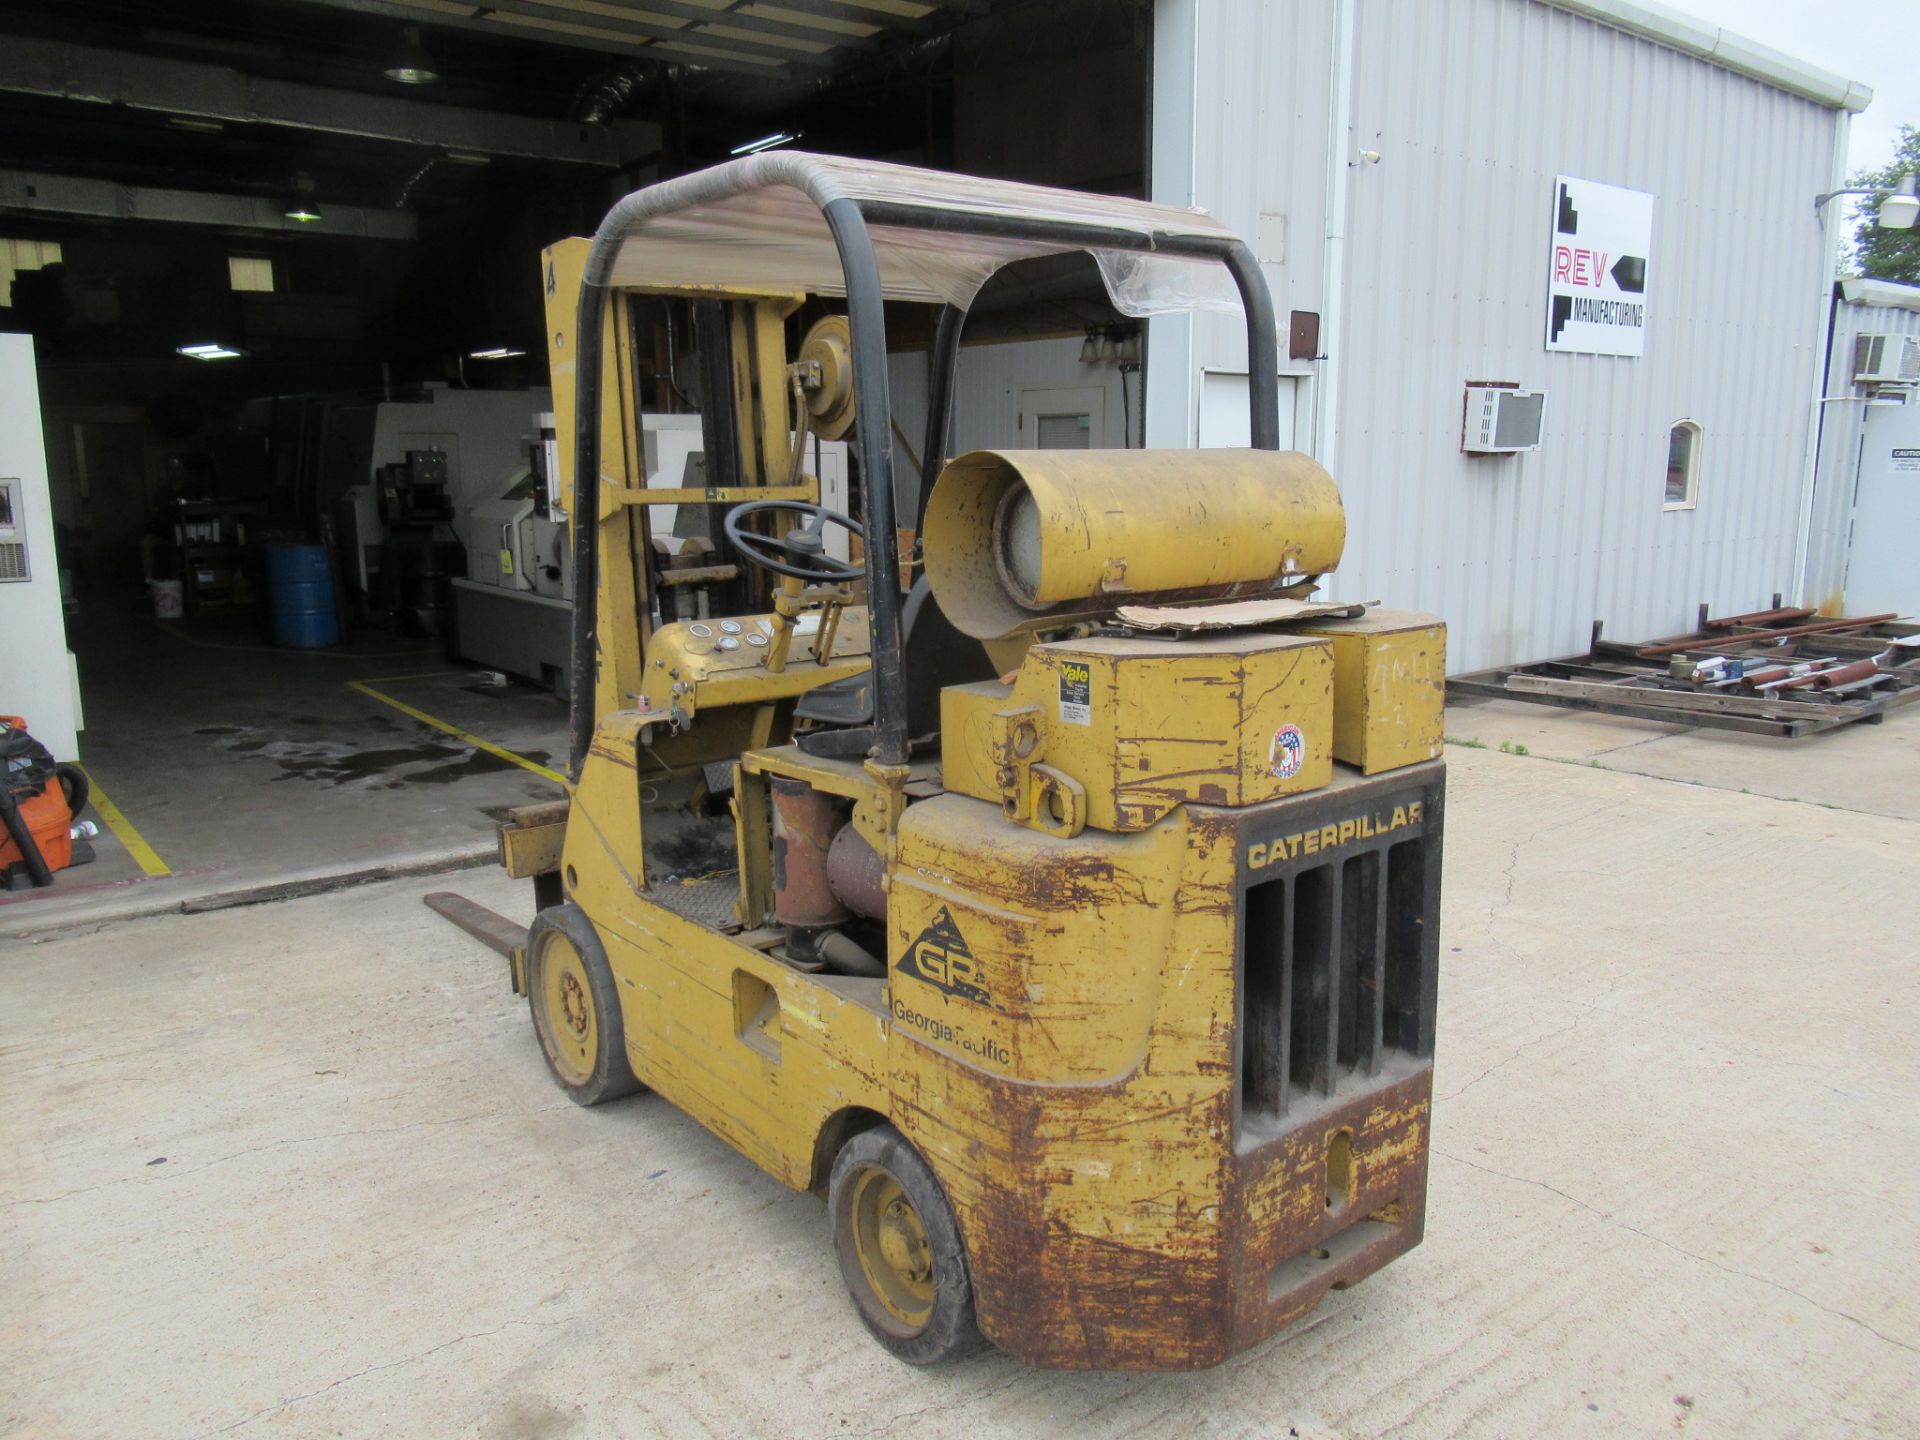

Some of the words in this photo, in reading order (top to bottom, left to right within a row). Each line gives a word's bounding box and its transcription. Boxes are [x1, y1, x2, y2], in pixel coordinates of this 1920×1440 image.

[1554, 246, 1607, 287] REV
[1573, 297, 1643, 328] MANUFACTURING
[1062, 663, 1089, 683] Yale
[1247, 801, 1423, 870] CATERPILLAR
[915, 940, 978, 989] GP
[894, 999, 953, 1042] Georgia
